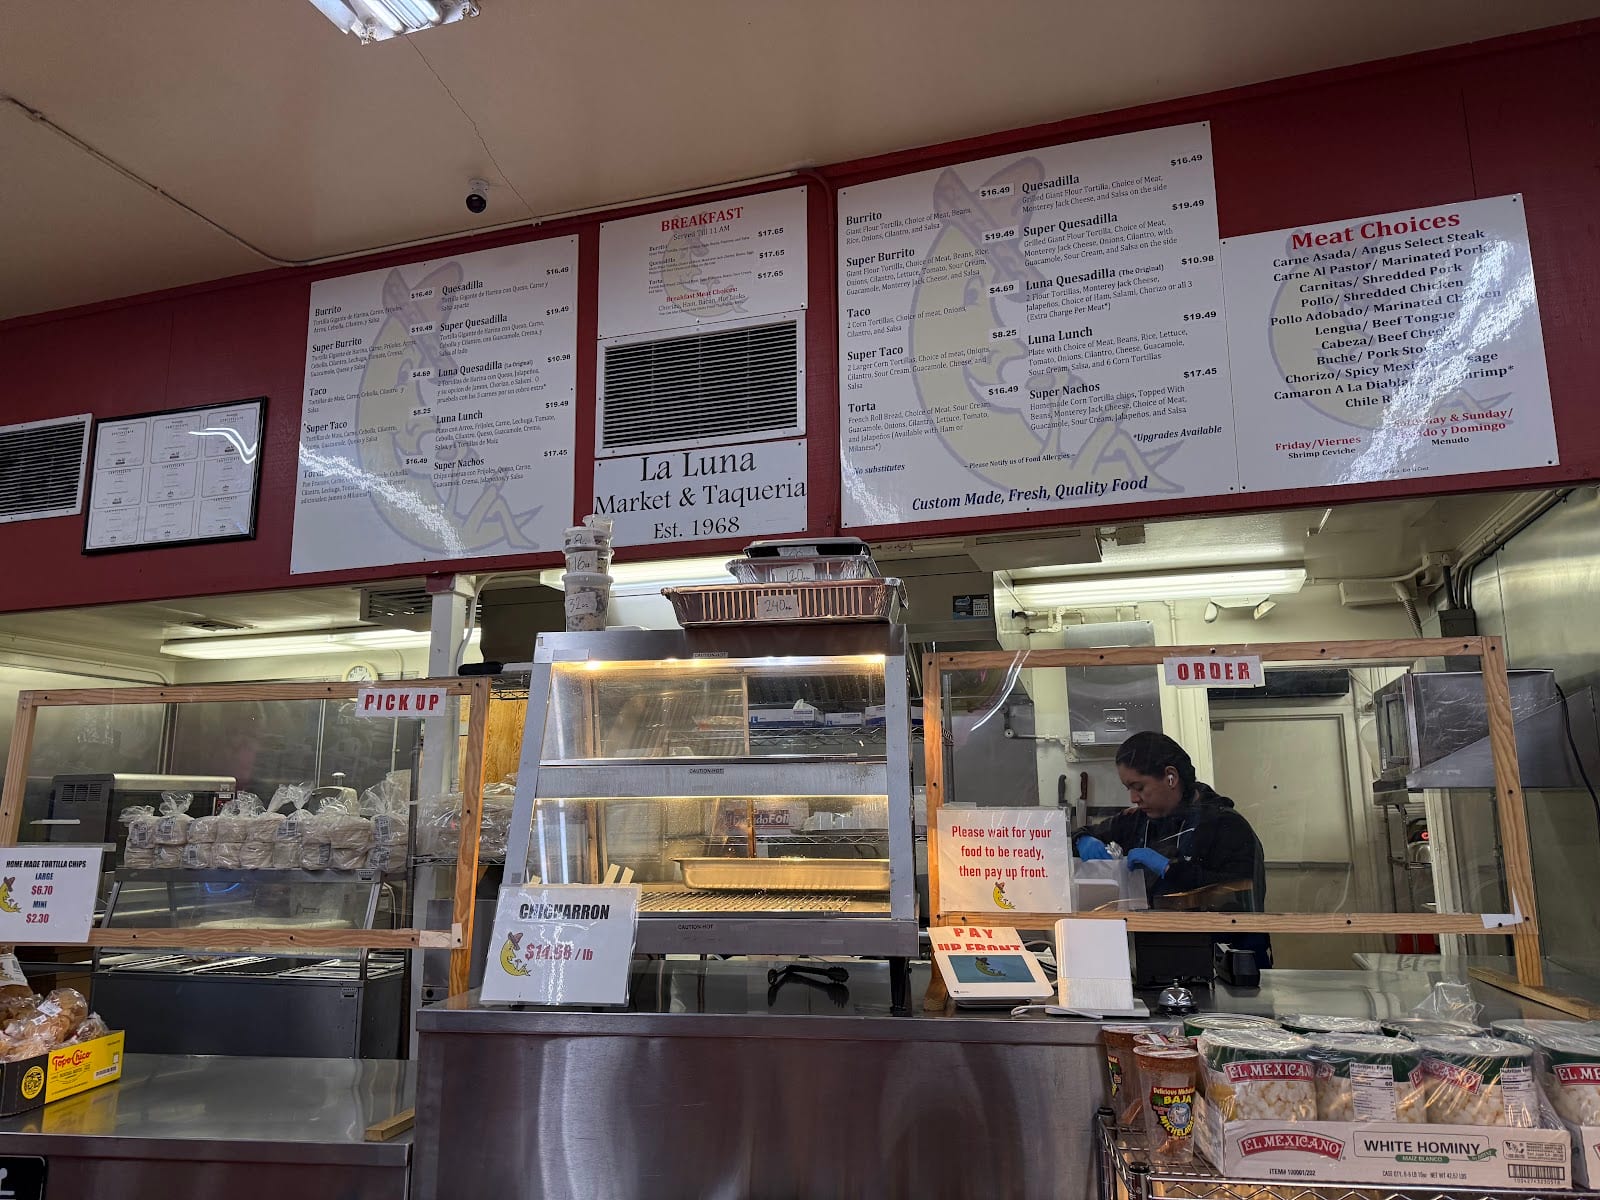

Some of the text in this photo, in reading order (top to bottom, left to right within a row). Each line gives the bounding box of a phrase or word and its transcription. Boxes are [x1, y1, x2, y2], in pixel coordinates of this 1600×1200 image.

[1170, 154, 1203, 166] $16.49
[981, 186, 1010, 197] $16.49
[1022, 175, 1080, 194] Quesadilla
[1055, 199, 1070, 209] Jack
[1096, 192, 1110, 201] and
[1111, 190, 1129, 199] Salsa
[1140, 186, 1152, 194] the
[1172, 199, 1205, 211] $19.49
[661, 207, 744, 231] BREAKFAST
[846, 212, 882, 225] Burrito
[1023, 213, 1118, 237] Super Quesadilla
[718, 224, 730, 232] AM
[758, 227, 784, 237] $17.65
[1291, 214, 1460, 249] Meat Choices
[985, 230, 1015, 241] $19.49
[1273, 229, 1485, 267] Carne Asada/ Angus Select Steak
[846, 248, 915, 267] Super Burrito
[1181, 255, 1214, 265] $10.98
[1273, 271, 1310, 282] Carne
[1313, 266, 1326, 277] Al
[1330, 259, 1378, 274] Pastor/
[1382, 249, 1451, 266] Marinated
[1026, 264, 1164, 290] Luna Quesadilla (The Original)
[1299, 263, 1462, 293] Carnitas/ Shredded Pork
[442, 280, 483, 295] Quesadilla
[989, 284, 1014, 294] $4.69
[1301, 280, 1464, 307] Pollo/ Shredded Chicken
[315, 306, 342, 317] Burrito
[846, 308, 871, 318] Taco
[1183, 311, 1217, 321] $19.49
[1271, 315, 1302, 326] Pollo
[1305, 305, 1370, 321] Adobado/
[1373, 296, 1442, 312] Marinated
[1315, 312, 1455, 335] Lengua/ Beef Tongue
[992, 329, 1017, 339] $8.25
[1028, 326, 1093, 345] Luna Lunch
[1321, 330, 1412, 349] Cabeza/ Beef
[847, 347, 903, 361] Super Taco
[1028, 348, 1045, 356] Plate
[1046, 345, 1062, 354] with
[1063, 343, 1086, 351] Choice
[1317, 348, 1403, 365] Buche/ Pork
[438, 361, 503, 377] Luna Quesadilla
[1183, 367, 1217, 379] $17.45
[1285, 366, 1379, 384] Chorizo/ Spicy
[988, 385, 1019, 396] $16.49
[1029, 383, 1100, 400] Super Nachos
[847, 403, 876, 413] Torta
[436, 410, 483, 424] Luna Lunch
[1180, 425, 1222, 437] Available
[1275, 438, 1361, 450] Friday/Viernes
[1431, 436, 1470, 445] Menudo
[990, 459, 1008, 467] Notify
[1025, 455, 1041, 463] Food
[1042, 453, 1070, 461] Allergies
[1288, 447, 1356, 459] Shrimp Ceviche
[642, 453, 757, 481] La Luna
[864, 464, 906, 474] substitutes
[593, 473, 809, 515] Market & Taqueria
[912, 475, 1148, 510] Custom Made, Fresh, Quality Food
[654, 516, 740, 539] Est. 1968
[1177, 662, 1250, 680] ORDER
[364, 694, 439, 711] PICK UP
[952, 825, 1052, 841] Please wait for your
[961, 845, 1044, 861] food to be ready,
[6, 860, 87, 868] HOME MADE TORTILLA CHIPS
[35, 872, 54, 880] LARGE
[959, 865, 1048, 880] then pay up front.
[31, 885, 53, 895] $6.70
[32, 900, 47, 908] MINI
[26, 913, 50, 924] $2.30
[519, 904, 610, 920] CHICHARRON
[953, 925, 993, 939] PAY
[52, 1050, 92, 1070] Topo Chico
[1164, 1095, 1192, 1104] BAJA
[1244, 1135, 1340, 1154] EL MEXICANO
[1364, 1140, 1480, 1154] WHITE HOMINY
